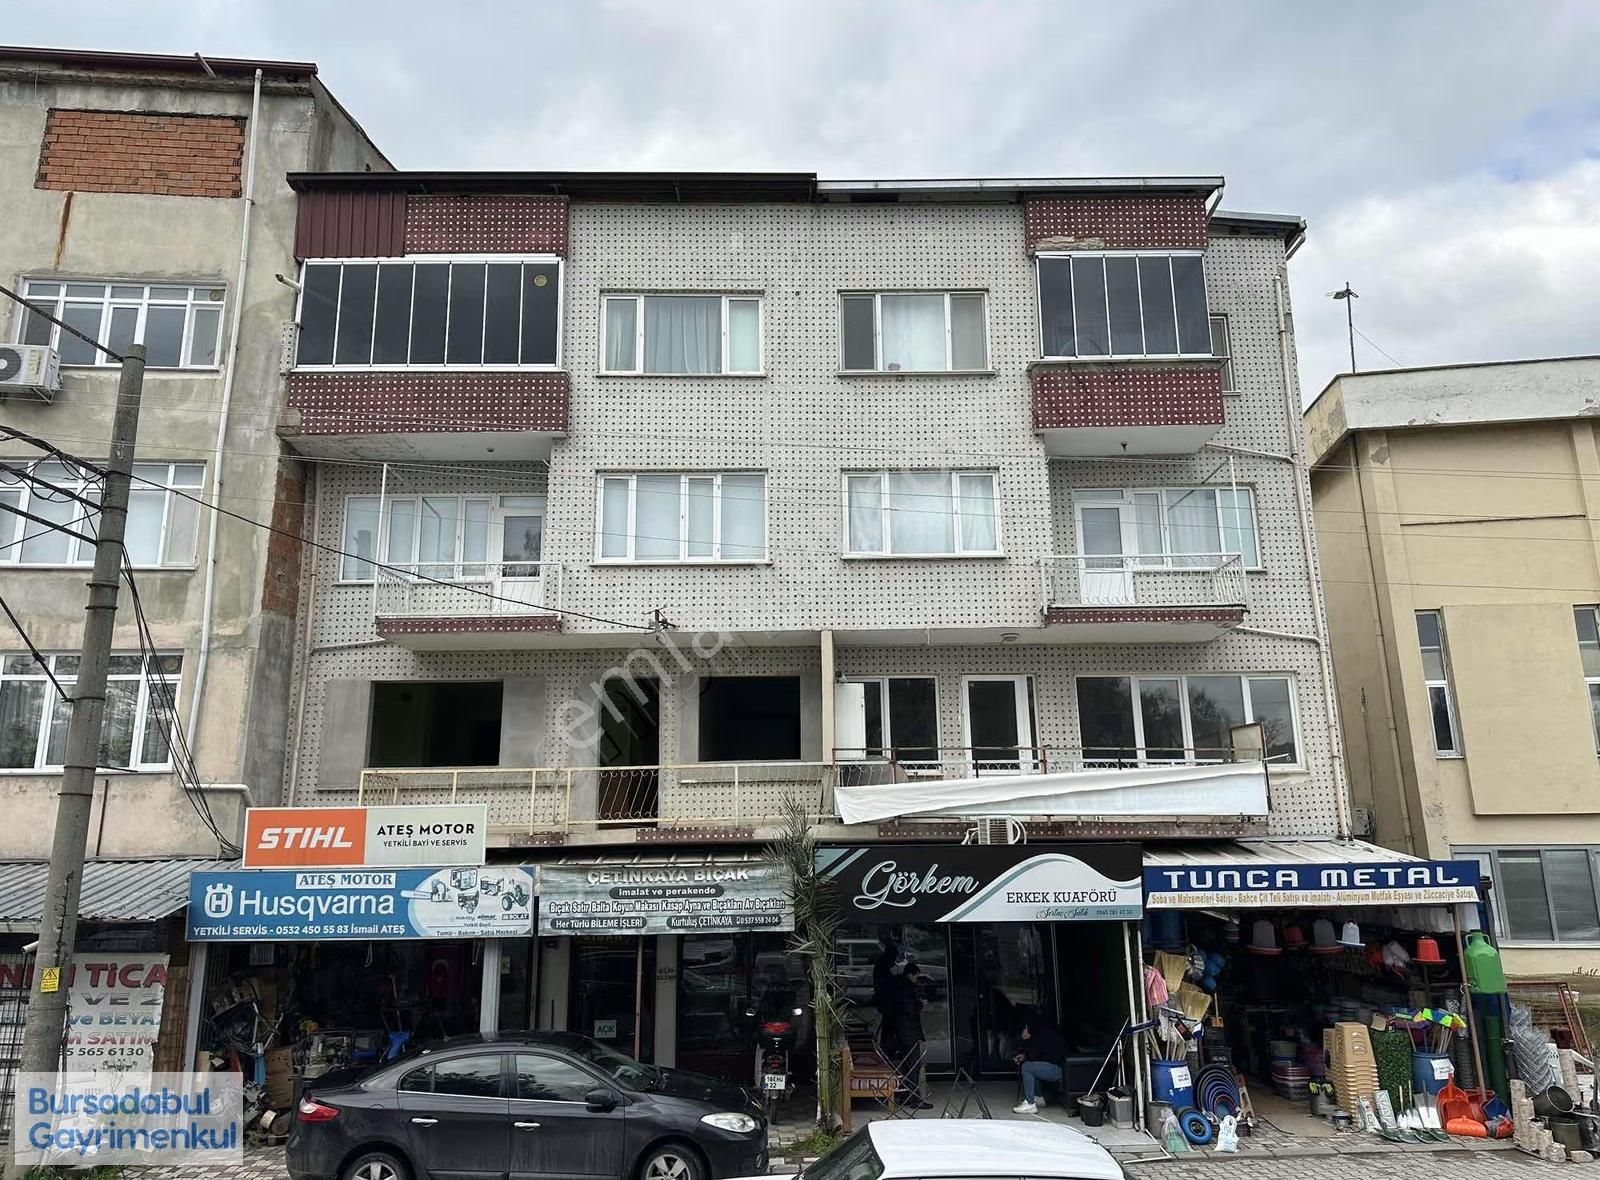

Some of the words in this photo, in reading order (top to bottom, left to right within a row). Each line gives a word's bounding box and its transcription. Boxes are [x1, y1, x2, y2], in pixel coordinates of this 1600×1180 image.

[257, 826, 353, 849] STIHL
[376, 824, 414, 838] ATEŞ
[419, 823, 475, 836] MOTOR
[383, 839, 411, 848] YETKİLİ
[412, 838, 429, 847] BAYİ
[430, 839, 441, 847] VE
[441, 838, 468, 847] SERVİS
[299, 874, 336, 888] ATEŞ
[340, 873, 393, 886] MOTOR
[587, 868, 688, 887] ÇETİNKAYA
[694, 867, 749, 884] BIÇAK
[1163, 870, 1299, 889] TUNCA
[1320, 866, 1459, 887] METAL
[651, 888, 663, 896] ve
[665, 886, 716, 897] perakende
[853, 860, 979, 910] Görkem
[1006, 891, 1050, 904] ERKEK
[1053, 888, 1118, 903] KUAFÖRÜ
[1151, 894, 1168, 904] Soba
[1169, 895, 1176, 904] ve
[1177, 893, 1214, 904] Malzemeleri
[1238, 892, 1258, 904] Bahçe
[1301, 893, 1309, 902] ve
[1336, 890, 1369, 903] Alüminyum
[1370, 889, 1392, 901] Mutfak
[1393, 889, 1413, 902] Eşyası
[1414, 890, 1422, 900] ve
[1423, 888, 1454, 901] Züccaciye
[239, 889, 395, 922] Husqvarna
[549, 901, 571, 916] Bıçak
[571, 901, 590, 914] Satır
[591, 901, 610, 913] Balta
[634, 899, 660, 912] Makası
[661, 899, 683, 913] Kasap
[702, 900, 711, 911] ve
[744, 897, 755, 910] Av
[193, 925, 231, 936] YETKİLİ
[232, 923, 268, 935] SERVİS
[276, 924, 300, 934] 0532
[302, 924, 321, 934] 450
[323, 924, 336, 934] 55
[336, 924, 349, 934] 83
[350, 922, 379, 934] İsmail
[380, 924, 406, 936] ATEŞ
[556, 920, 570, 928] Her
[571, 919, 590, 928] Türlü
[590, 918, 618, 928] BİLEME
[619, 917, 643, 928] İŞLERİ
[671, 916, 698, 928] Kurtuluş
[698, 915, 733, 927] ÇETİNKAYA
[80, 992, 129, 1006] VE
[77, 1047, 104, 1057] 565
[108, 1047, 144, 1057] 6130
